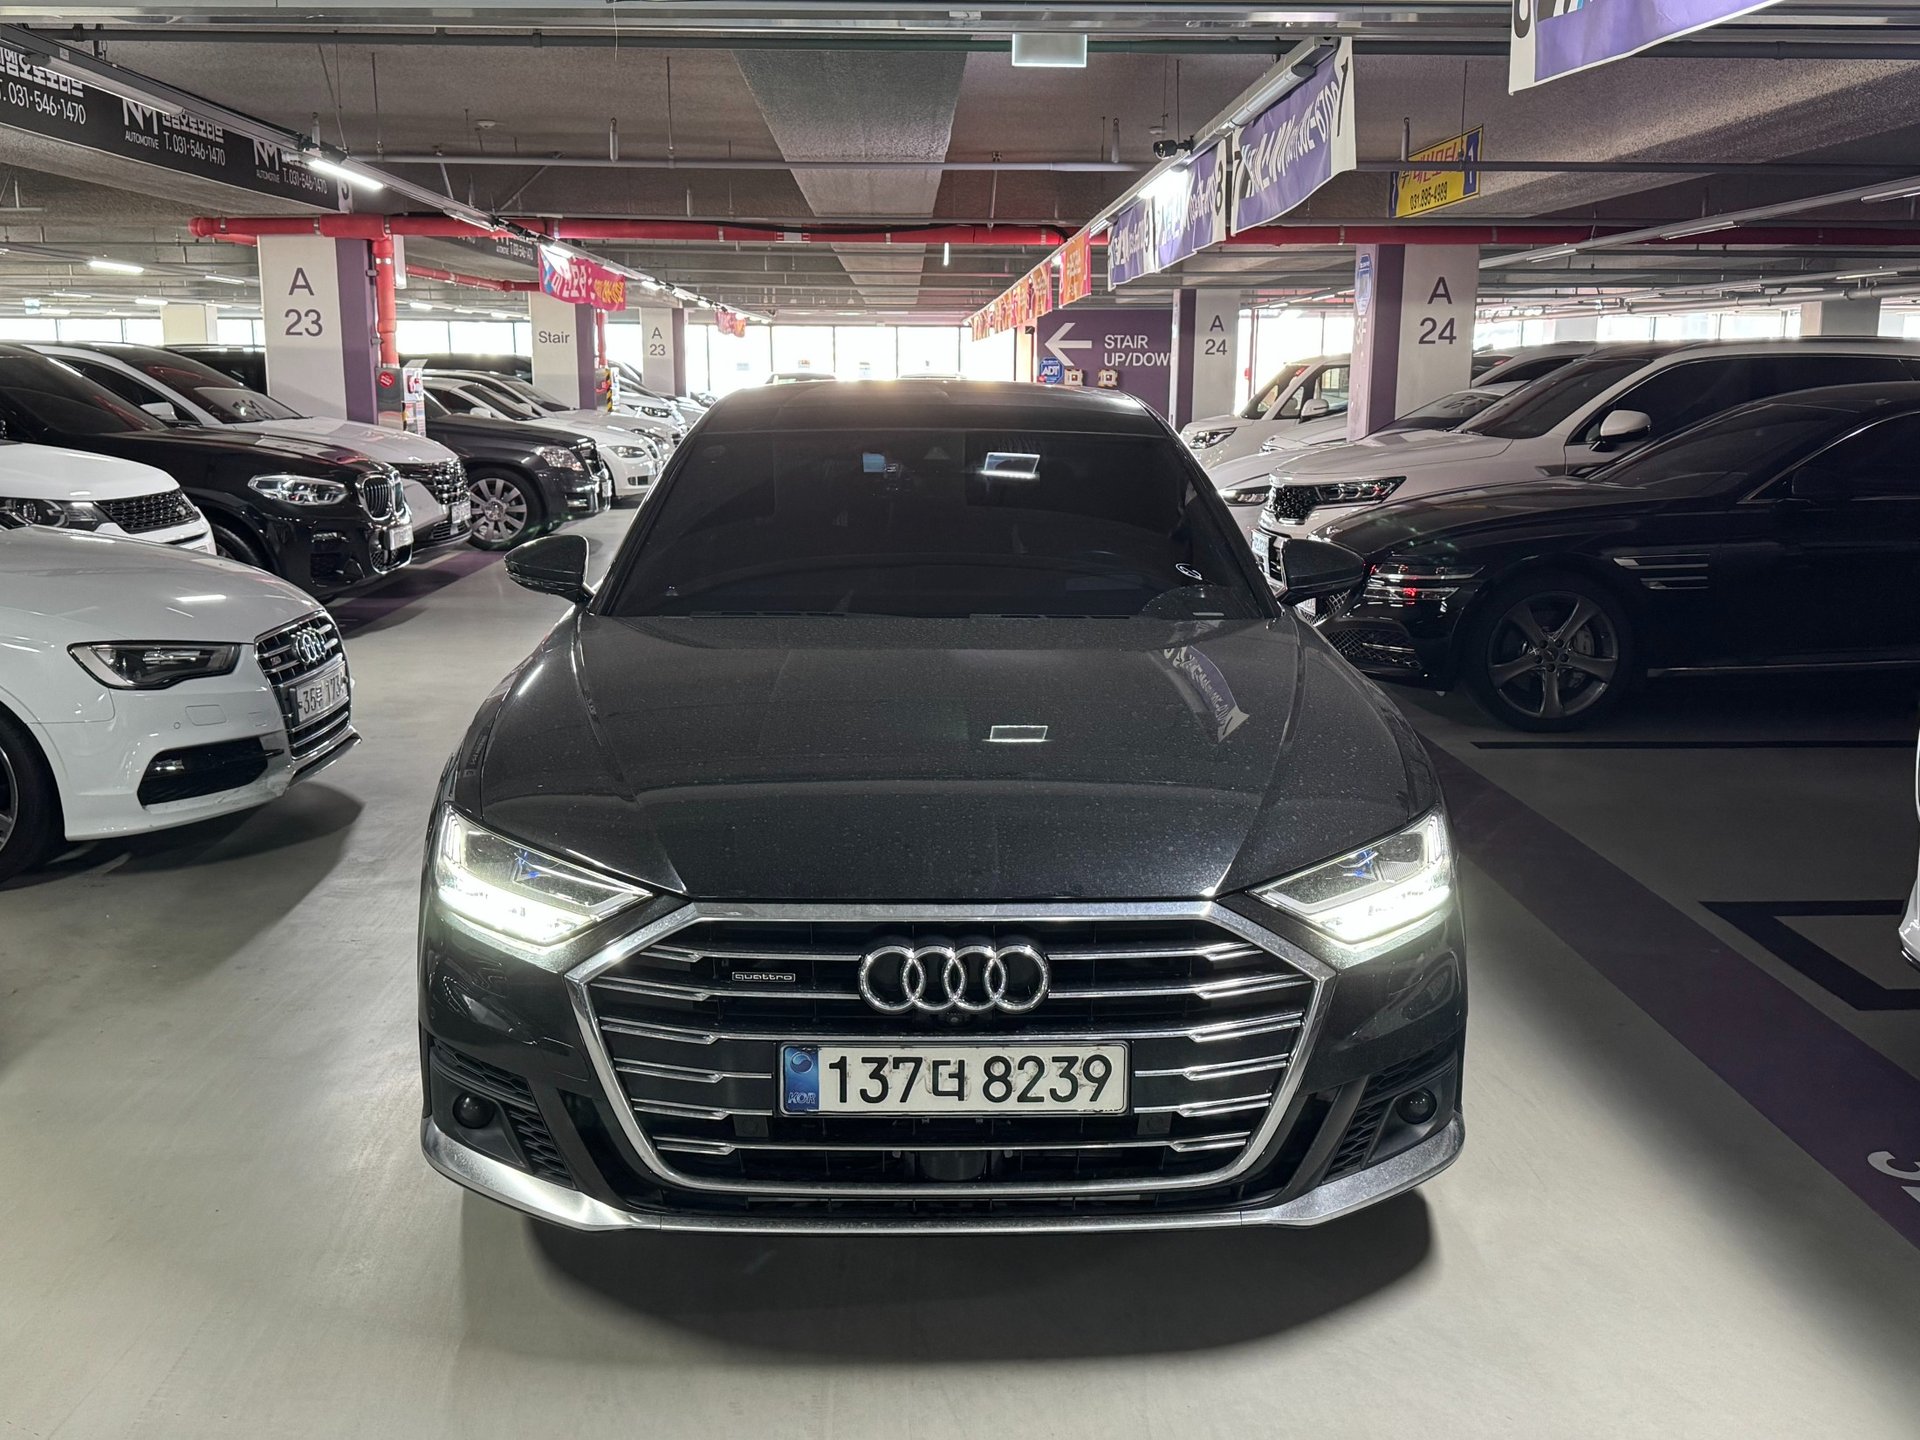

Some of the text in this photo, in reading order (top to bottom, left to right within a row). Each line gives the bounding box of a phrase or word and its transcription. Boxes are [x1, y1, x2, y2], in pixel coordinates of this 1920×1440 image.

[125, 131, 160, 150] AUTOMOTIVE
[288, 267, 314, 296] A
[1427, 276, 1452, 304] A
[284, 308, 323, 337] 23
[1210, 315, 1225, 332] A
[538, 330, 570, 344] Stair
[651, 327, 663, 340] A
[1418, 317, 1457, 345] 24
[1104, 334, 1149, 349] STAIR
[1204, 338, 1228, 356] 24
[649, 343, 666, 357] 23
[1104, 352, 1171, 367] UP/DOW
[1041, 366, 1059, 376] ADT
[734, 973, 793, 981] quattro
[828, 1054, 1113, 1103] 137더 8239
[788, 1092, 816, 1105] KOR
